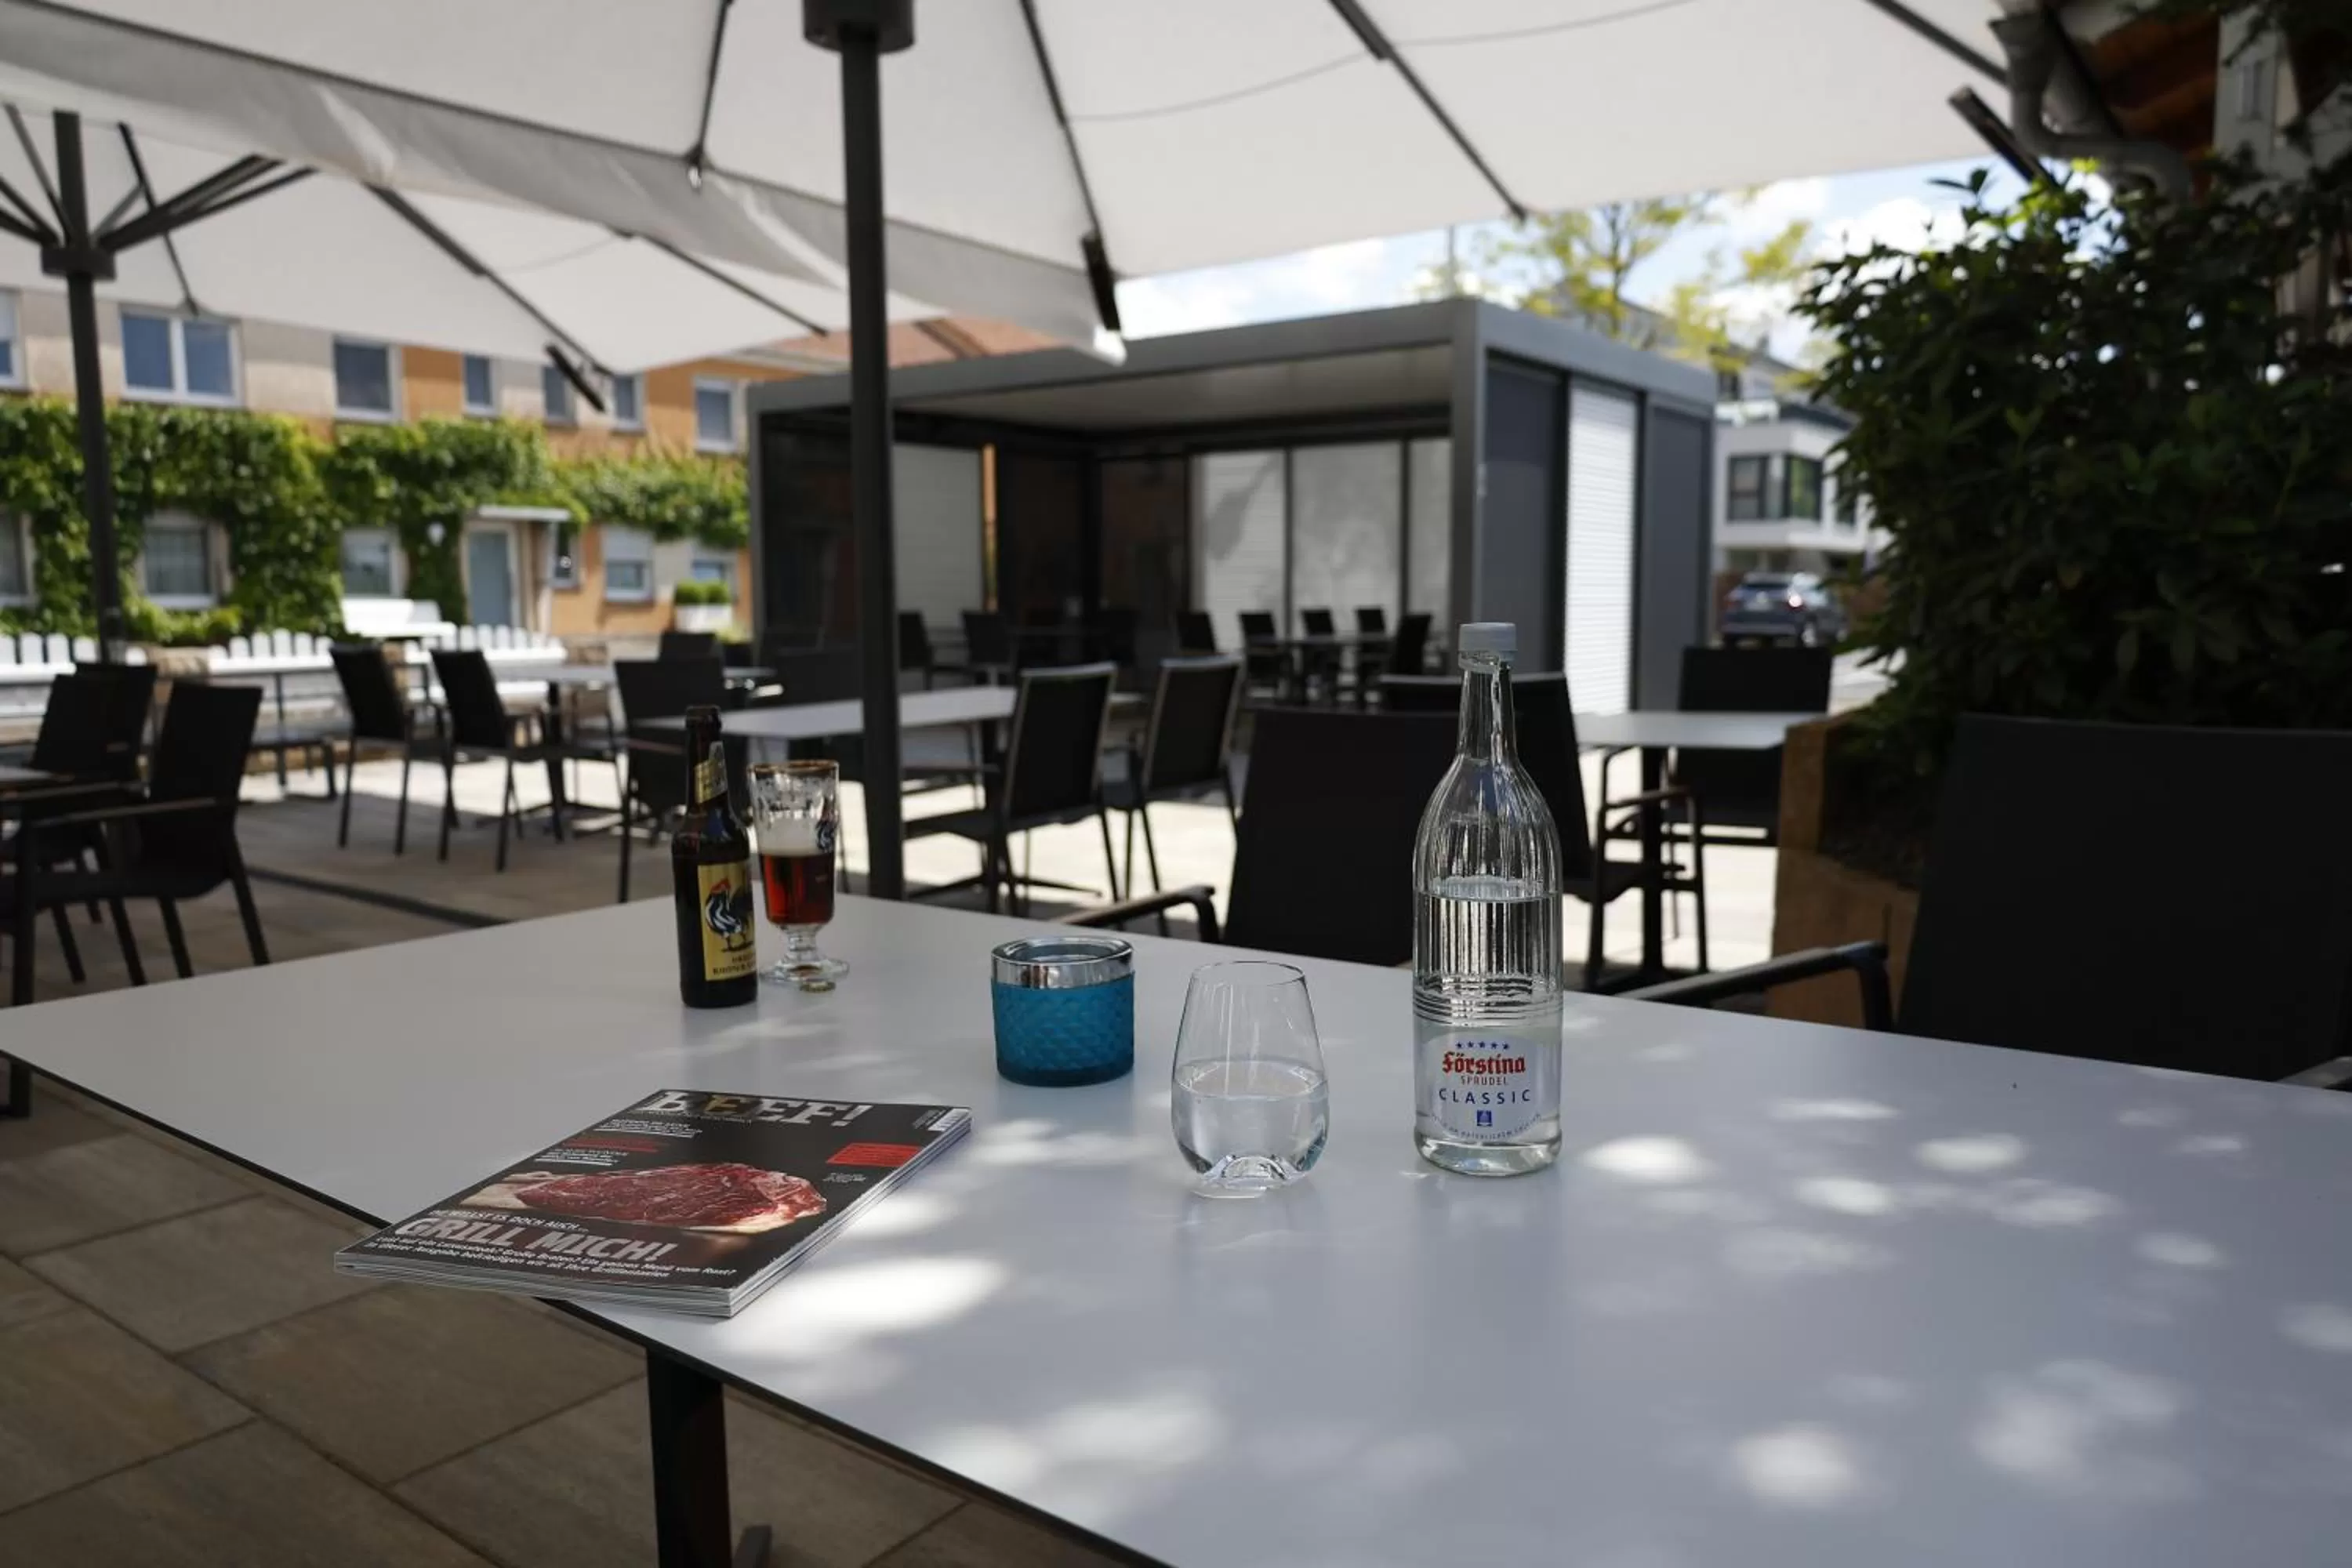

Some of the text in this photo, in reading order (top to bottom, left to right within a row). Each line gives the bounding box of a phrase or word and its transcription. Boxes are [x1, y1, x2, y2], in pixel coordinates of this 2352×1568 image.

[1442, 1051, 1526, 1075] Förstina
[1461, 1075, 1508, 1086] SPRUDEL
[1439, 1087, 1531, 1105] CLASSIC
[394, 1218, 527, 1246] GRILL
[524, 1232, 679, 1261] MICH!
